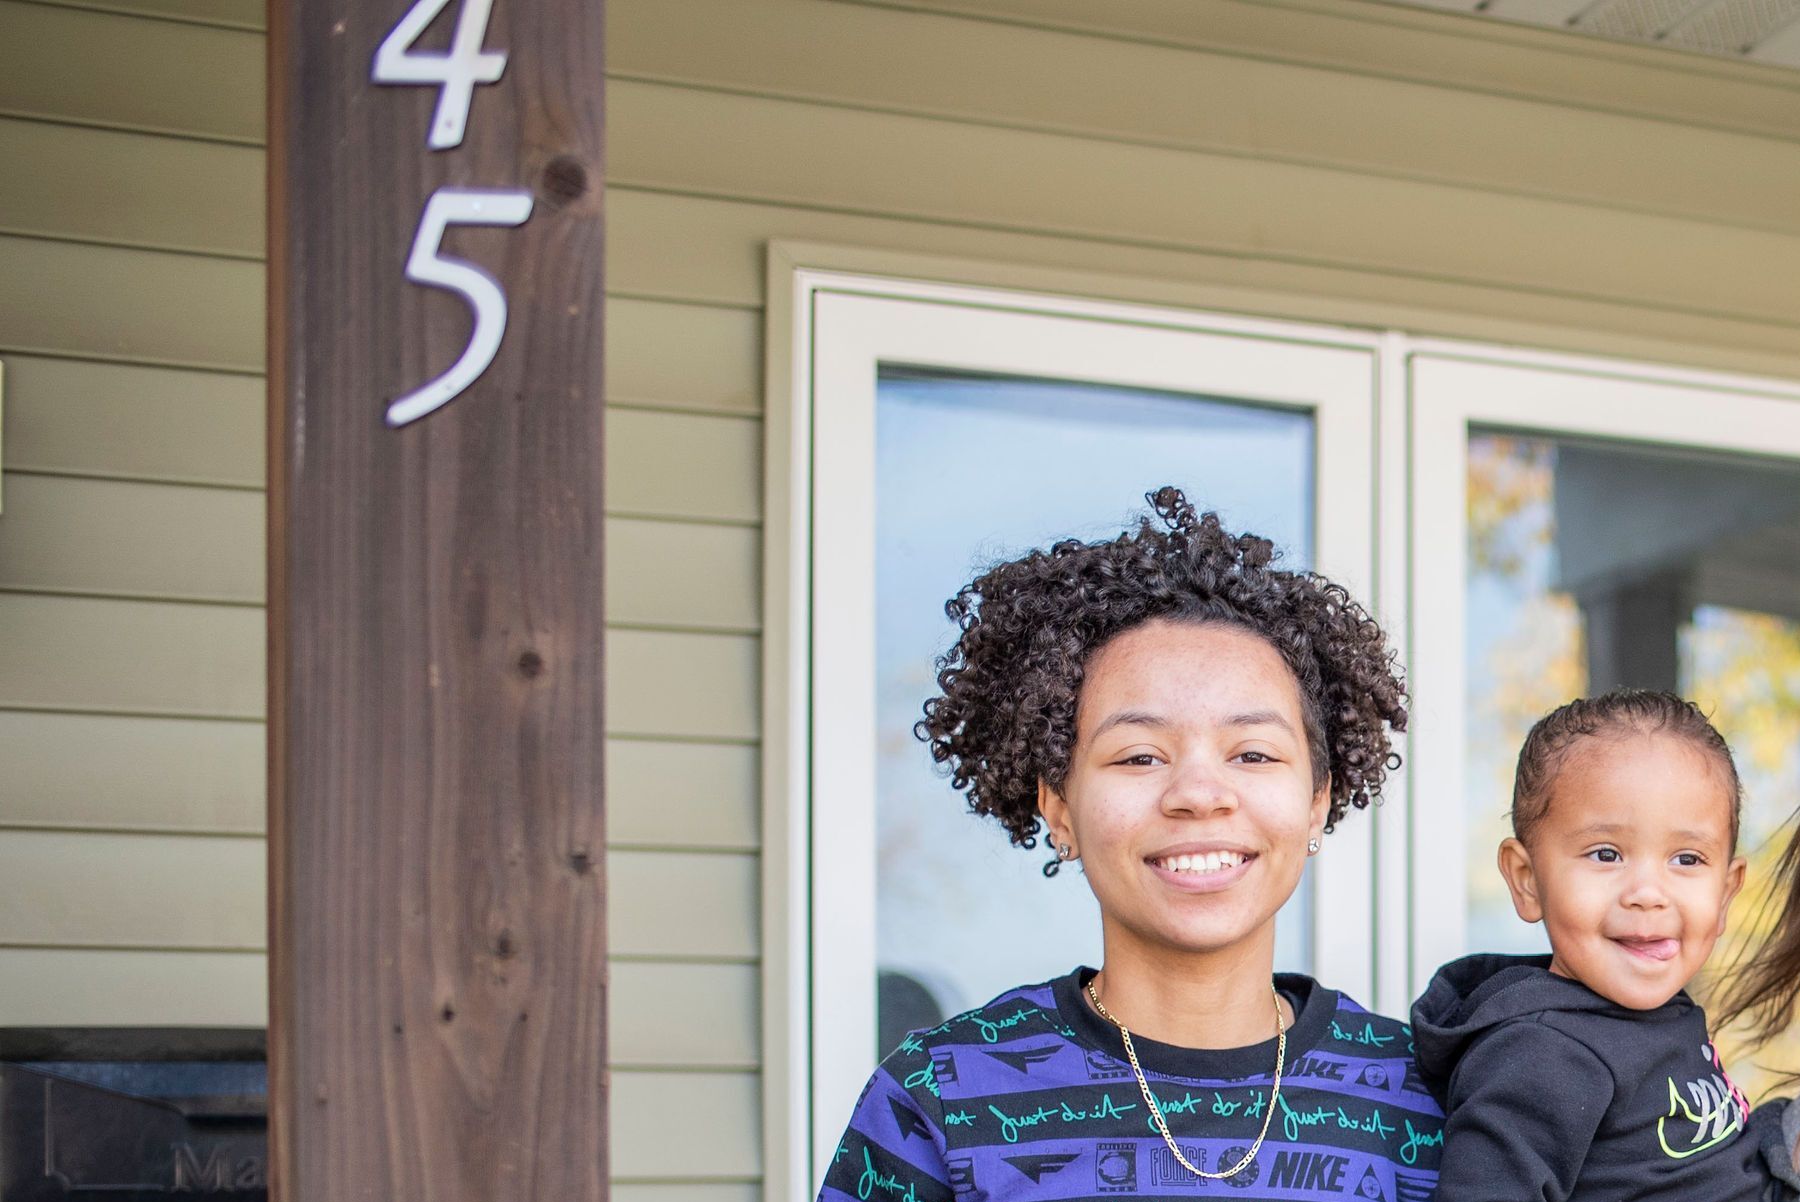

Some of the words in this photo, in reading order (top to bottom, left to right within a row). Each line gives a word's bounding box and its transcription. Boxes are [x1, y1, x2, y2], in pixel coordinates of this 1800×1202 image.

[987, 1103, 1060, 1144] Just
[1276, 1092, 1338, 1143] Just
[1267, 1150, 1351, 1193] NIKE
